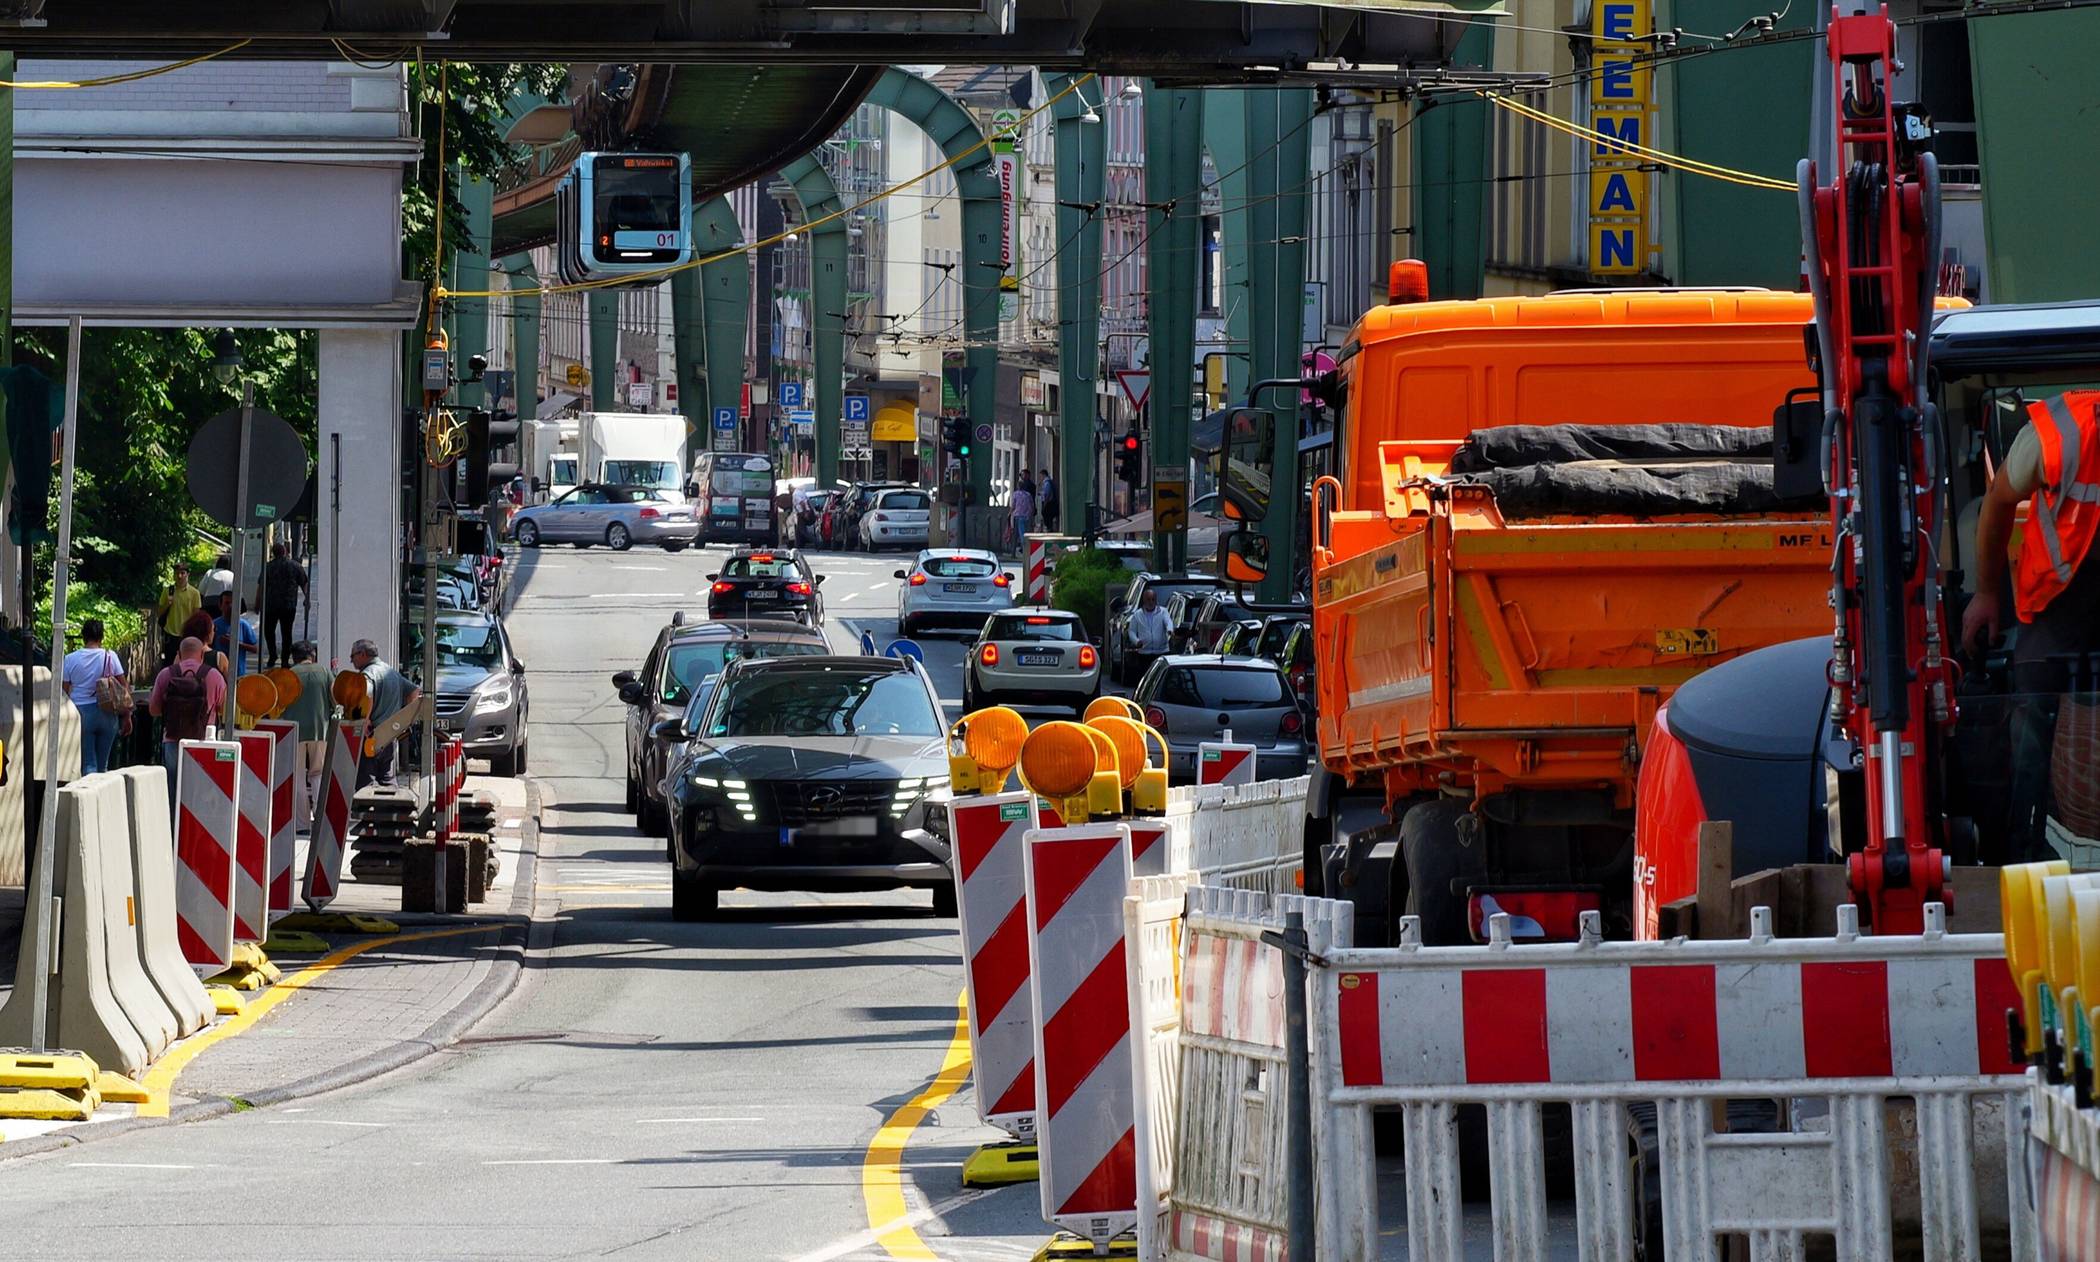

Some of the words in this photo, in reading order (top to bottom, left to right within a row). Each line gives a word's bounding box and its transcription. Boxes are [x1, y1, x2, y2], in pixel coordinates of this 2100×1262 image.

[1178, 96, 1186, 110] 7
[602, 236, 608, 246] 2
[656, 233, 675, 247] 01
[977, 234, 988, 245] 10
[1779, 535, 1813, 547] MF
